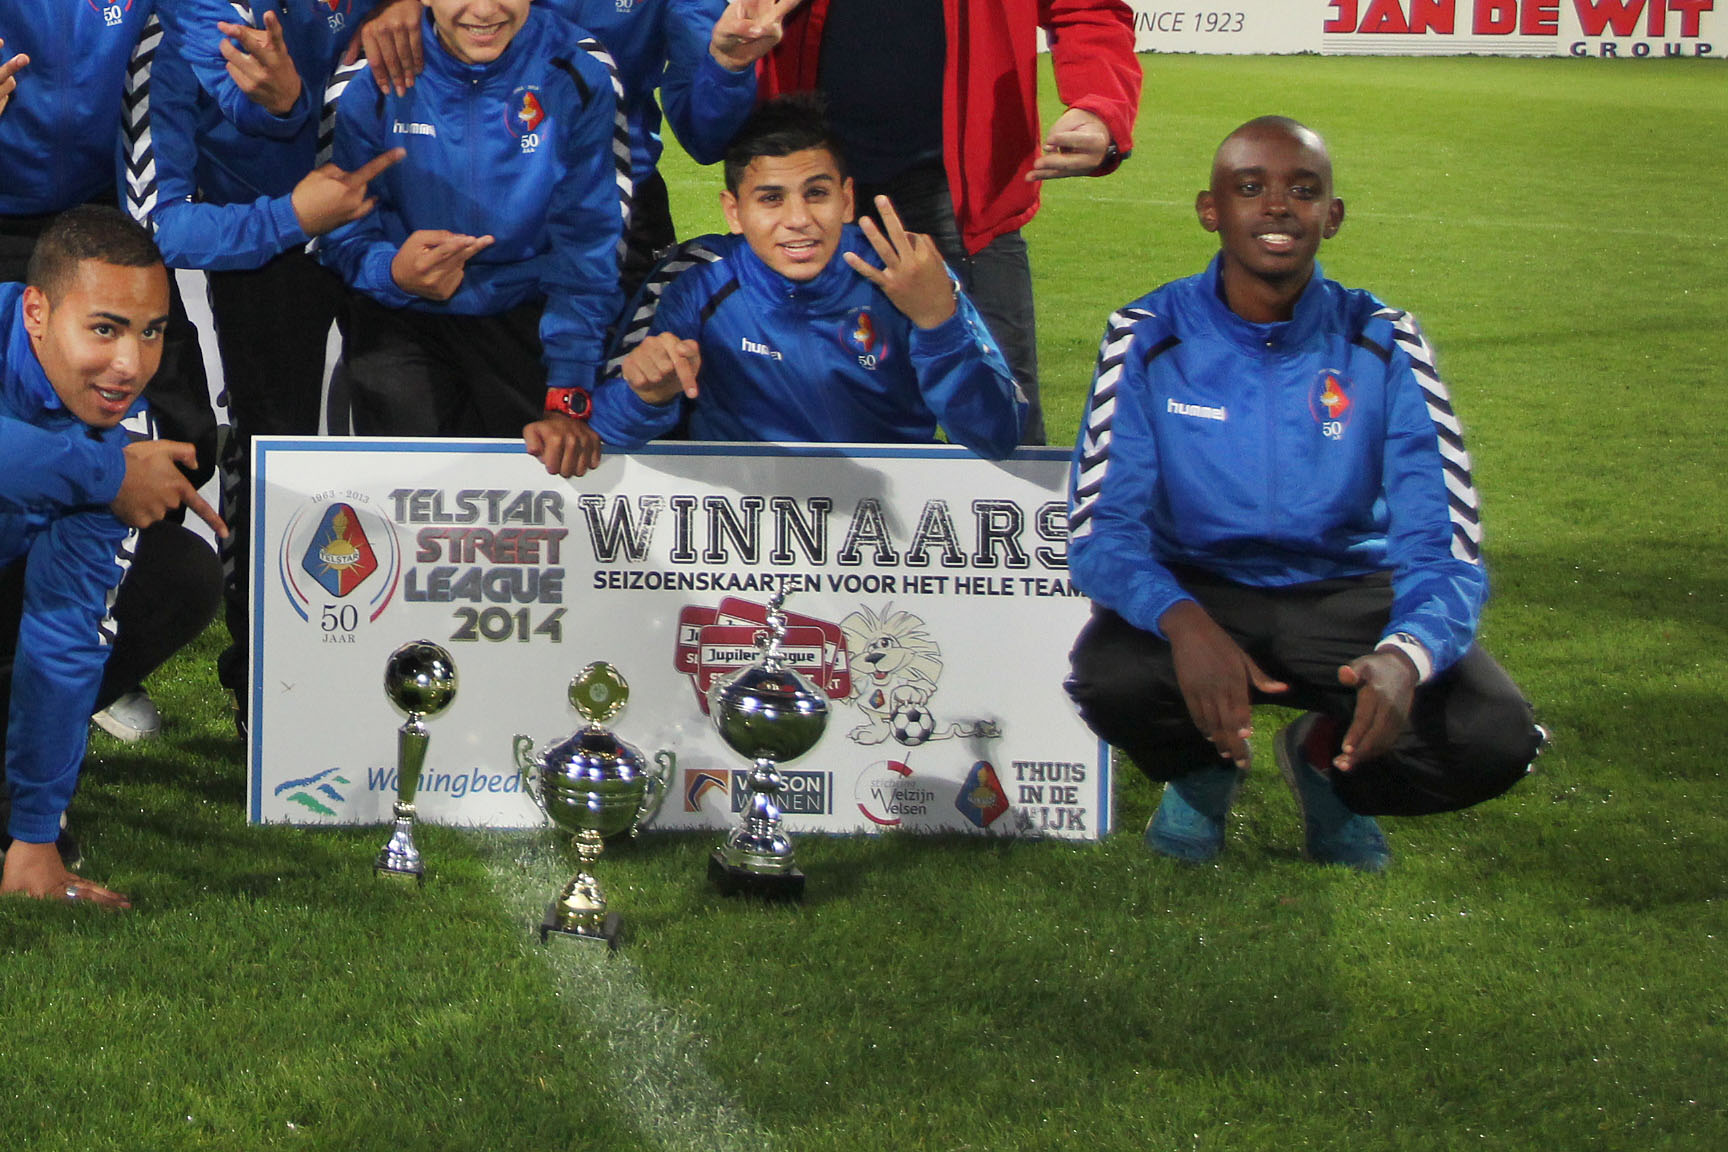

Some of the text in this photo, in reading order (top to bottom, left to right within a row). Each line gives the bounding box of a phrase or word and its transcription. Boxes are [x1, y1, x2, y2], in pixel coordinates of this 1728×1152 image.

[103, 5, 122, 22] 50
[327, 12, 345, 29] 50
[1133, 11, 1246, 33] INCE 1923
[1570, 41, 1713, 58] GROUP
[520, 133, 539, 149] 50
[858, 354, 877, 368] 50
[1167, 398, 1227, 422] hummel
[1322, 421, 1342, 437] 50
[388, 488, 565, 525] TELSTAR
[577, 493, 1069, 570] WINNAARS
[415, 526, 569, 565] STREET
[318, 550, 360, 565] TELSTAR
[403, 565, 566, 604] LEAGUE
[592, 569, 823, 594] SEIZOENSKAARTEN
[827, 574, 897, 594] VOOR
[902, 575, 949, 596] HET
[954, 577, 1013, 597] HELE
[320, 604, 359, 632] 50
[448, 605, 569, 643] 2014
[321, 632, 357, 644] JAAR
[707, 648, 761, 663] Jupiler
[1011, 760, 1086, 783] THUIS
[736, 774, 820, 792] VSON
[736, 792, 820, 810] WNEN
[1018, 784, 1044, 804] IN
[1048, 785, 1079, 805] DE
